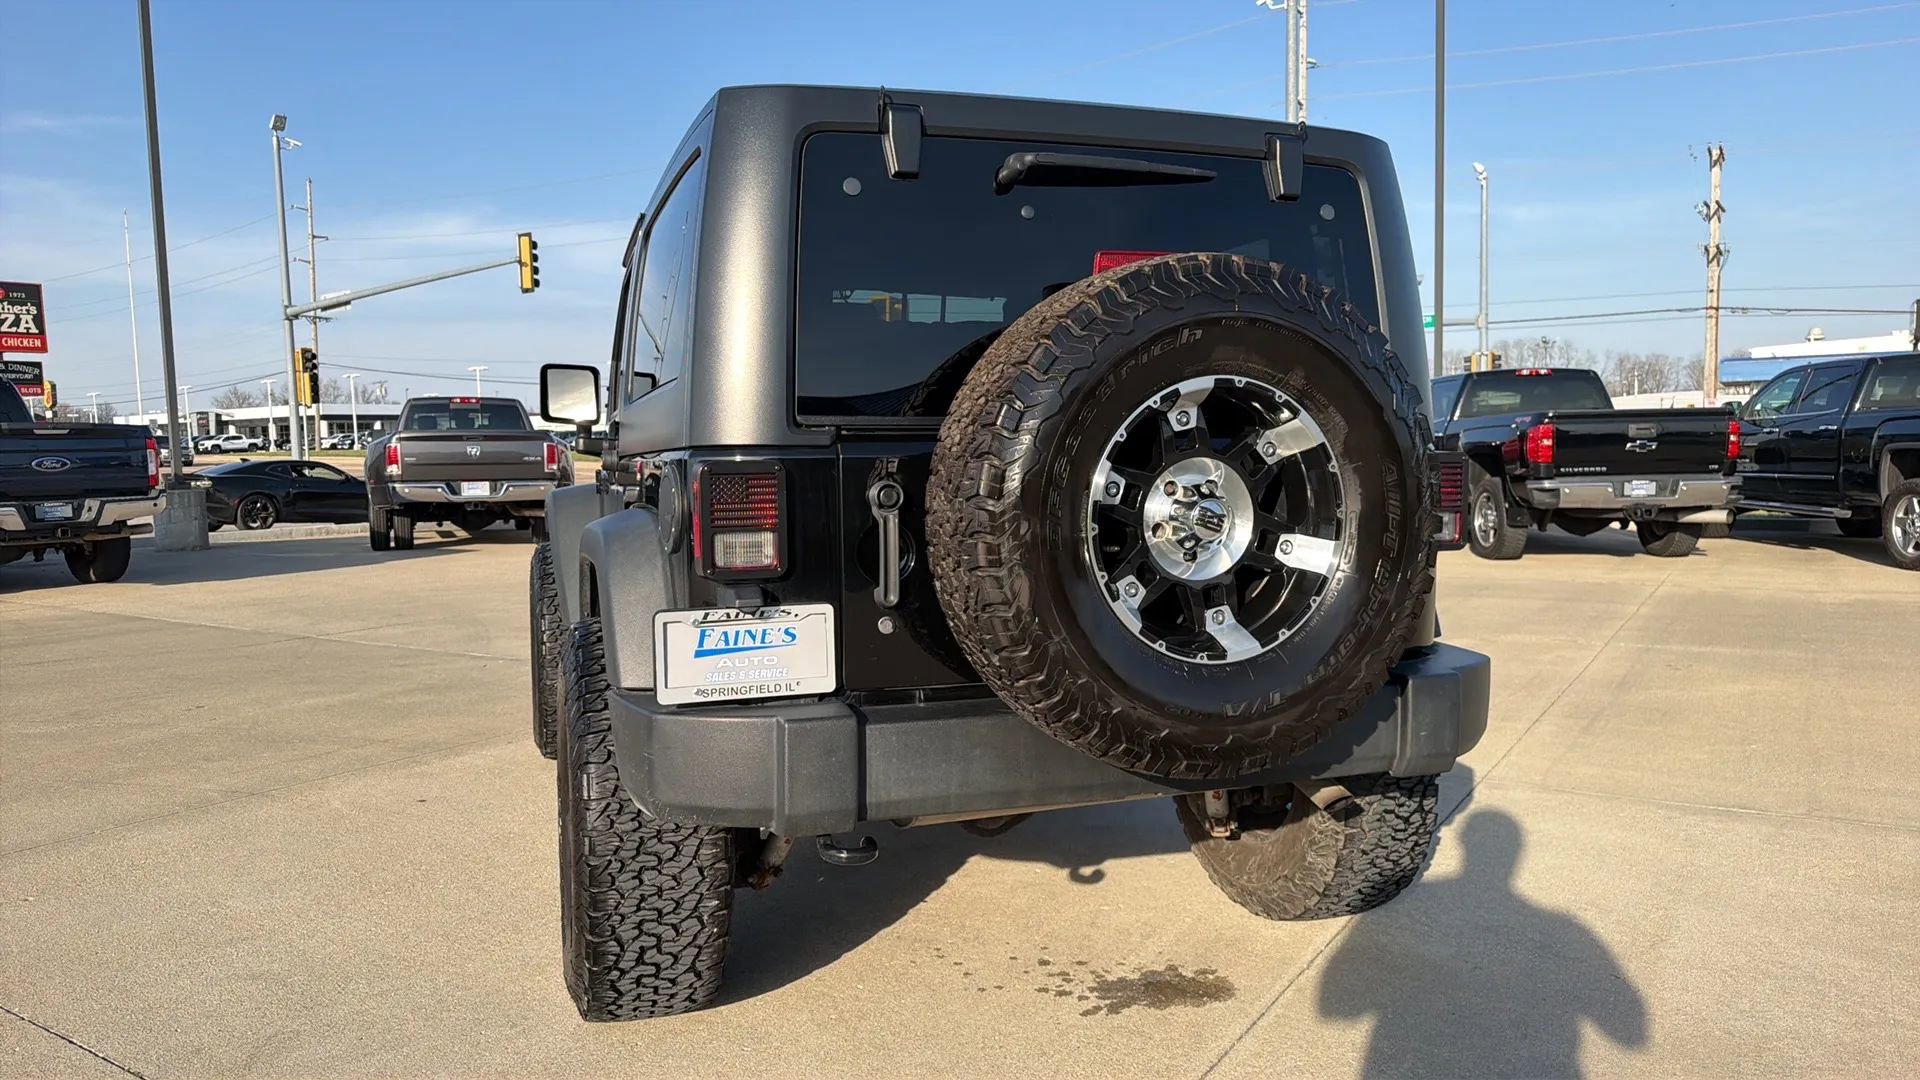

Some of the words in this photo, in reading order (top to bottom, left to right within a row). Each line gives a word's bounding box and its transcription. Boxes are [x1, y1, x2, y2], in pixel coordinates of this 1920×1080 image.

[2, 337, 42, 348] CHICKEN
[8, 363, 40, 376] DINNER
[697, 626, 797, 649] FAINE'S
[717, 656, 778, 668] AUTO
[705, 672, 735, 682] SALES
[749, 669, 788, 680] SERVICE
[702, 683, 782, 698] SPRINGFIELD
[785, 683, 795, 692] IL
